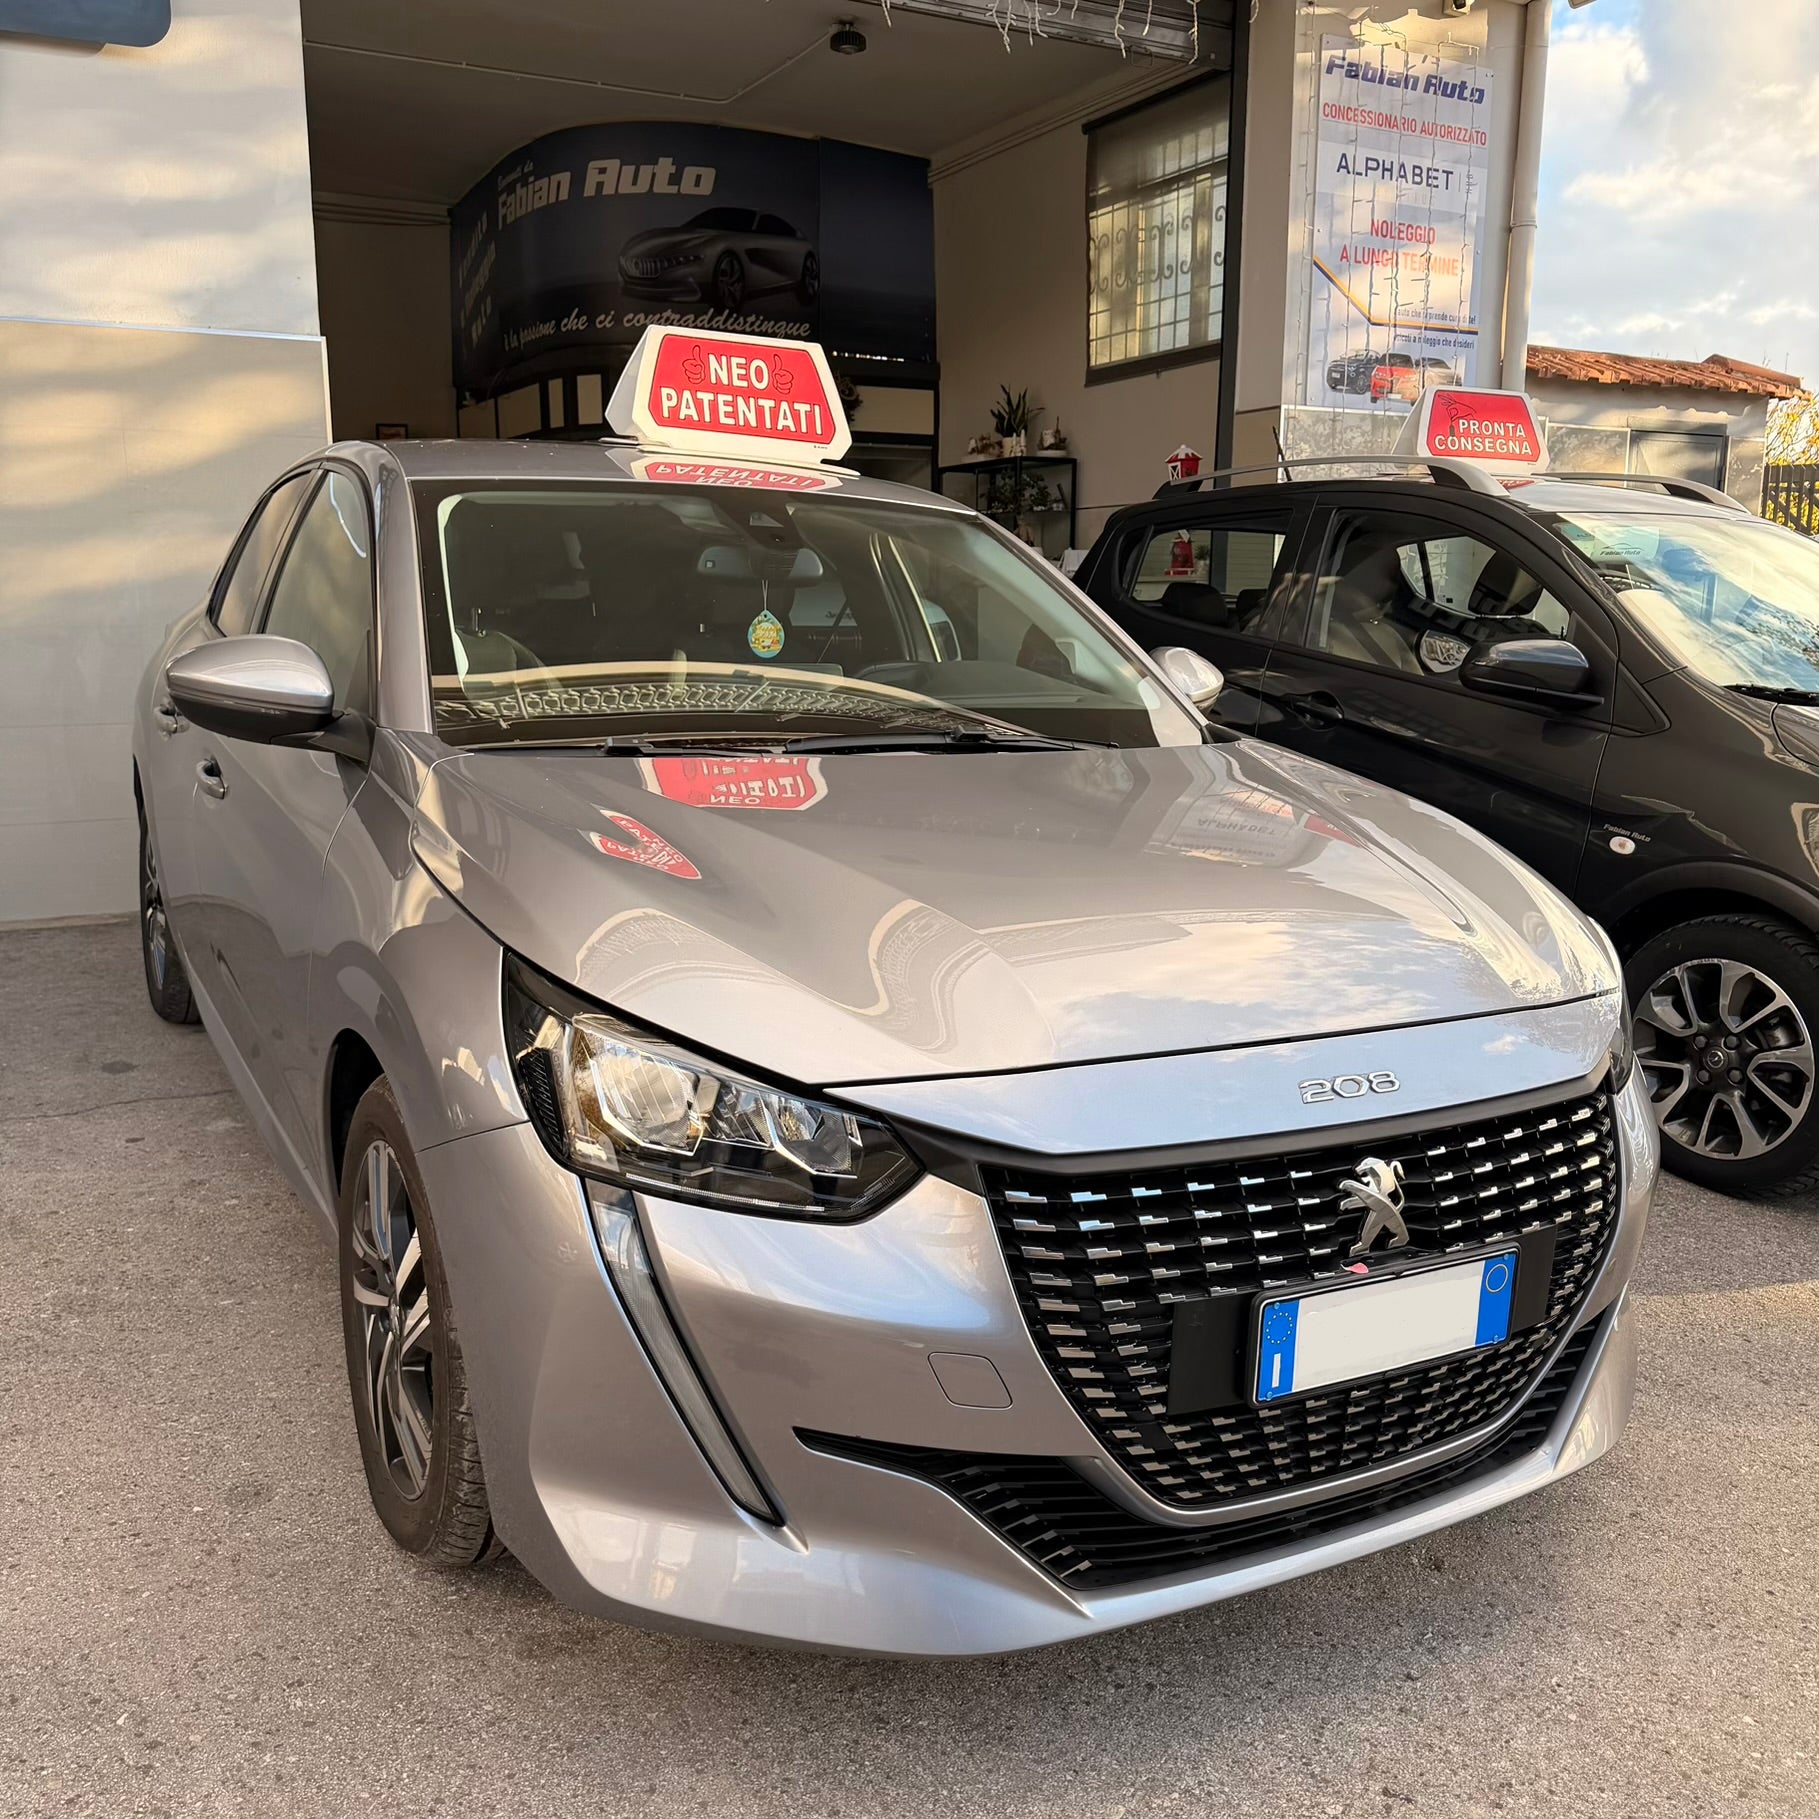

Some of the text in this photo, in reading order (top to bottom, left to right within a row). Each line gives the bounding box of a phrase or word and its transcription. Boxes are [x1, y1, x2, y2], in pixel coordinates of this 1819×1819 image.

[1325, 54, 1485, 105] Fabian Auto
[1322, 102, 1487, 146] CONCESSIONARIO AUTORIZZATO
[1336, 152, 1454, 190] ALPHABET
[499, 170, 571, 231] Fabian
[584, 157, 716, 198] Auto
[1370, 218, 1436, 245] NOLEGGIO
[1340, 244, 1350, 262] A
[510, 333, 518, 348] la
[518, 321, 555, 351] passione
[561, 308, 588, 331] che
[596, 310, 615, 329] ci
[1411, 309, 1422, 318] che
[1428, 311, 1448, 322] prende
[1442, 336, 1452, 347] che
[708, 353, 770, 389] NEO
[660, 386, 823, 436] PATENTATI
[1458, 418, 1527, 438] PRONTA
[1434, 435, 1533, 457] CONSEGNA
[1603, 823, 1652, 842] Fabian Auto
[1298, 1070, 1401, 1104] 208
